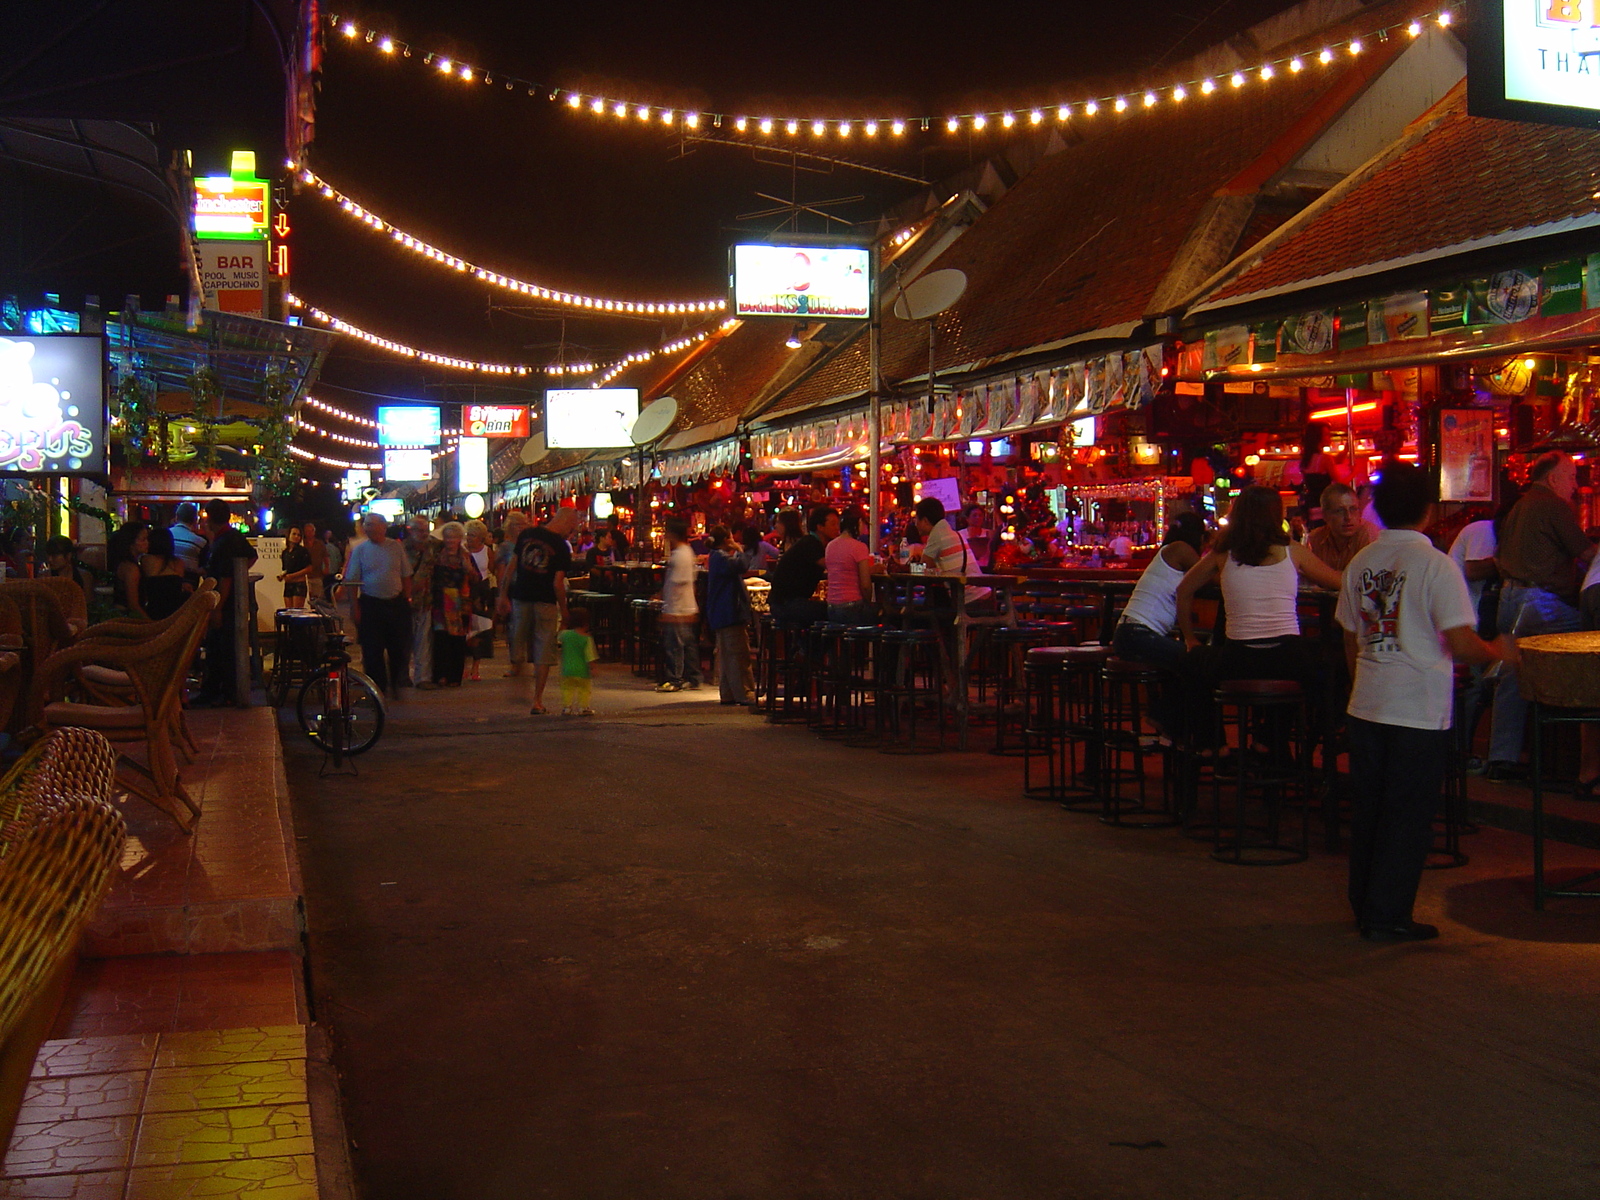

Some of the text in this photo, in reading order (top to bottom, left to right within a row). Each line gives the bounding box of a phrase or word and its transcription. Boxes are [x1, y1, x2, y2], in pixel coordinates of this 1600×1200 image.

[1538, 48, 1600, 76] THA
[195, 194, 264, 213] inchester
[217, 256, 254, 269] BAR
[204, 271, 259, 280] POOL MUSIC
[204, 280, 260, 289] CAPPUCHINO
[1550, 281, 1581, 294] Heineken
[739, 294, 797, 314] DRINKS
[487, 421, 512, 432] BAR
